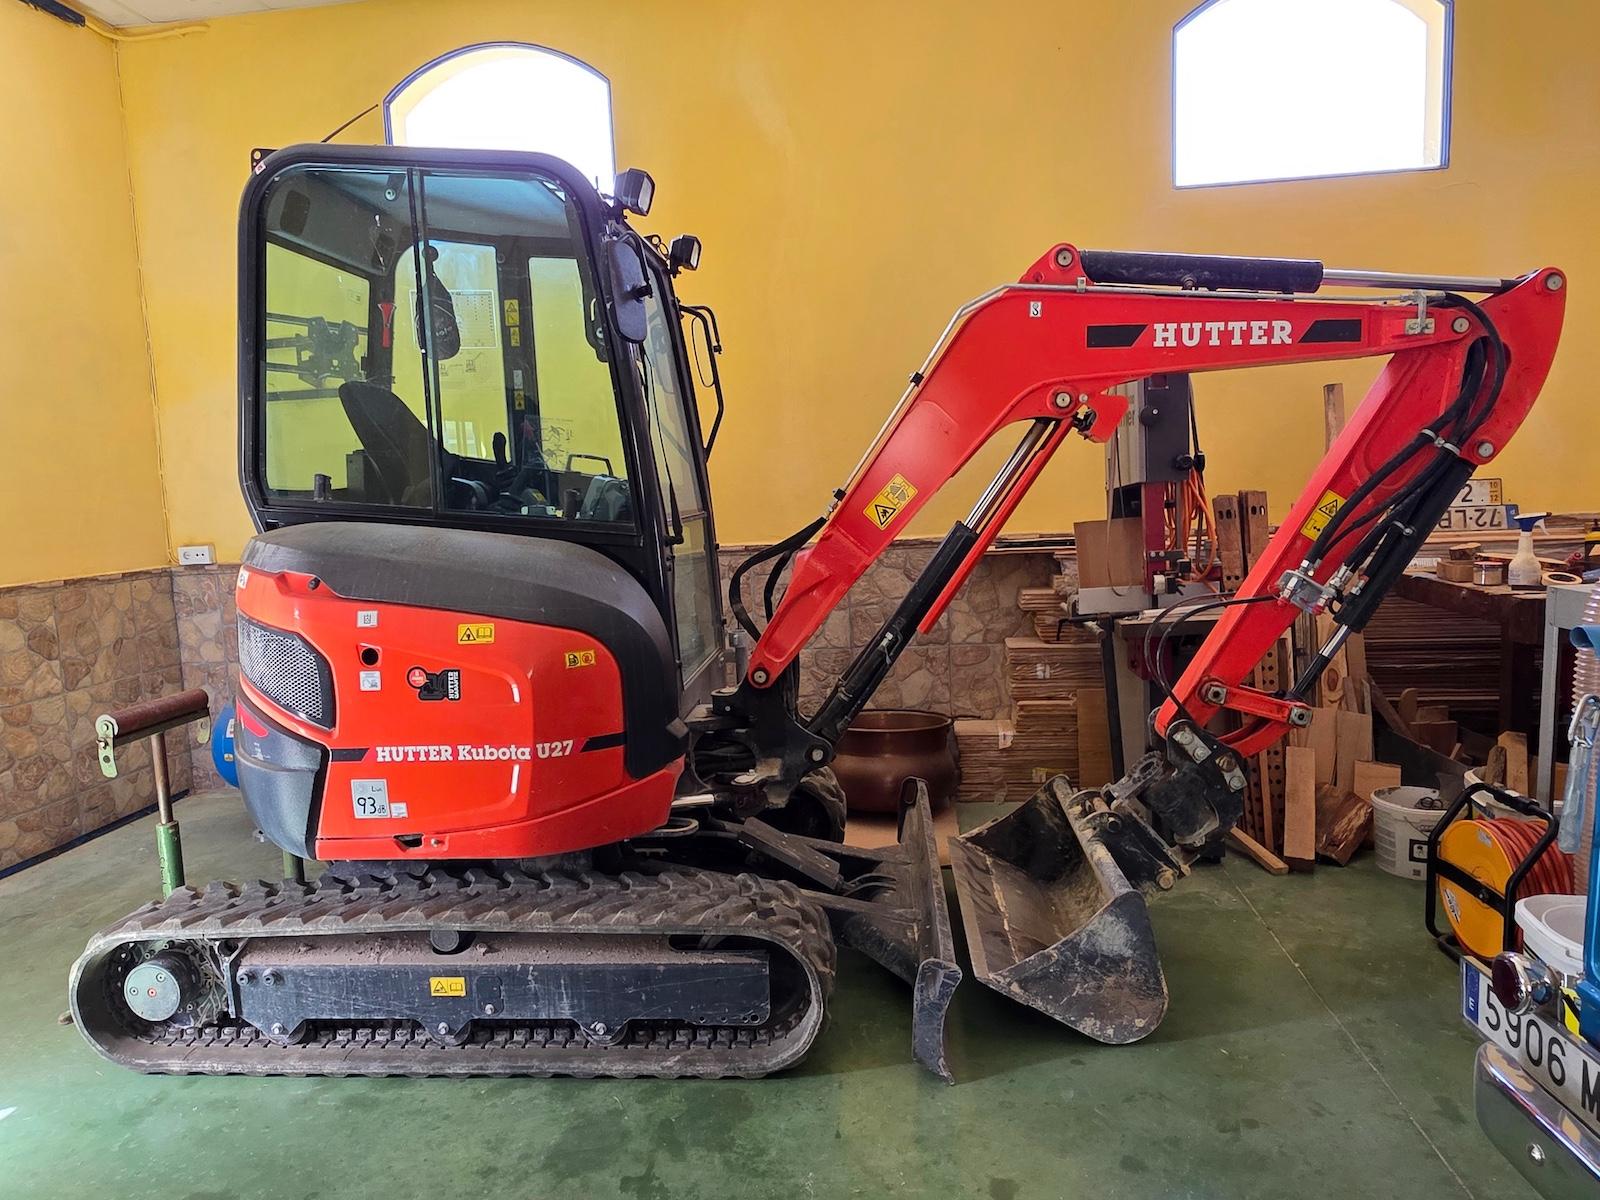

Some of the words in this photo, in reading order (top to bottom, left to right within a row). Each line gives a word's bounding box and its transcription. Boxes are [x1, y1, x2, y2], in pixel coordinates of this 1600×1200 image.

[1153, 320, 1292, 347] HUTTER
[1489, 481, 1498, 489] 10
[1489, 494, 1499, 504] 12
[376, 746, 453, 762] HUTTER
[457, 744, 531, 761] Kubota
[536, 740, 574, 758] U27
[357, 796, 377, 814] 93
[1485, 983, 1567, 1087] 5906
